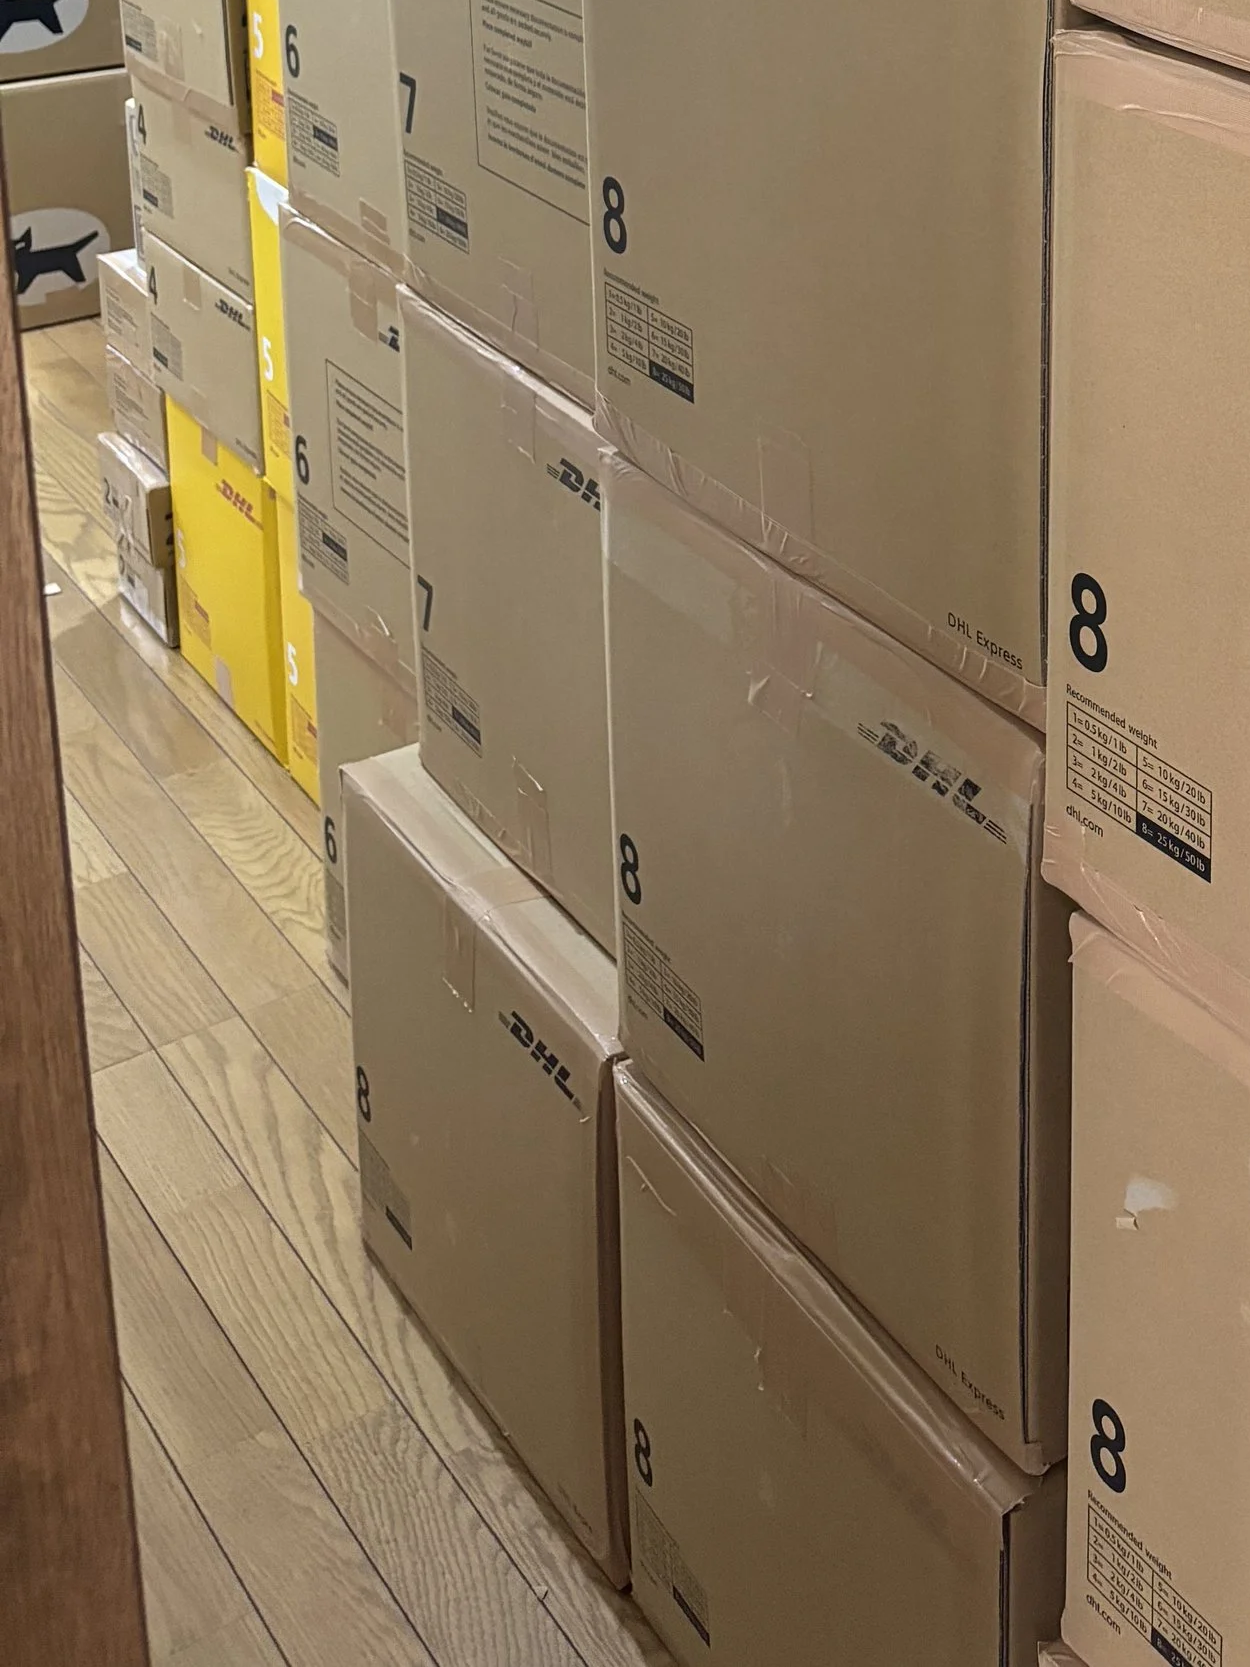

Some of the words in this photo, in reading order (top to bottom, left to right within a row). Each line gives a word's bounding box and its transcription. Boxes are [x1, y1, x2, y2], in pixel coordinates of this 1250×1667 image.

[252, 12, 265, 60] 5
[284, 24, 300, 78] 6
[138, 104, 147, 145] 4
[399, 72, 416, 134] 7
[209, 125, 237, 152] DHL
[603, 175, 628, 254] 8
[149, 266, 158, 305] 4
[263, 337, 275, 383] 5
[295, 435, 310, 486] 6
[559, 458, 602, 512] DH
[220, 478, 256, 524] DHL
[417, 574, 433, 631] 7
[1069, 572, 1108, 673] 8
[285, 640, 299, 687] 5
[947, 611, 973, 640] DHL
[975, 630, 1024, 670] Express
[877, 720, 986, 825] DHL
[325, 816, 337, 864] 6
[1066, 804, 1104, 837] dhl.com
[619, 833, 642, 905] 8
[509, 1011, 577, 1102] DHL
[356, 1065, 371, 1122] 8
[935, 1343, 958, 1378] DHL
[960, 1371, 1005, 1420] Express
[633, 1417, 654, 1488] 8
[1090, 1398, 1126, 1493] 8
